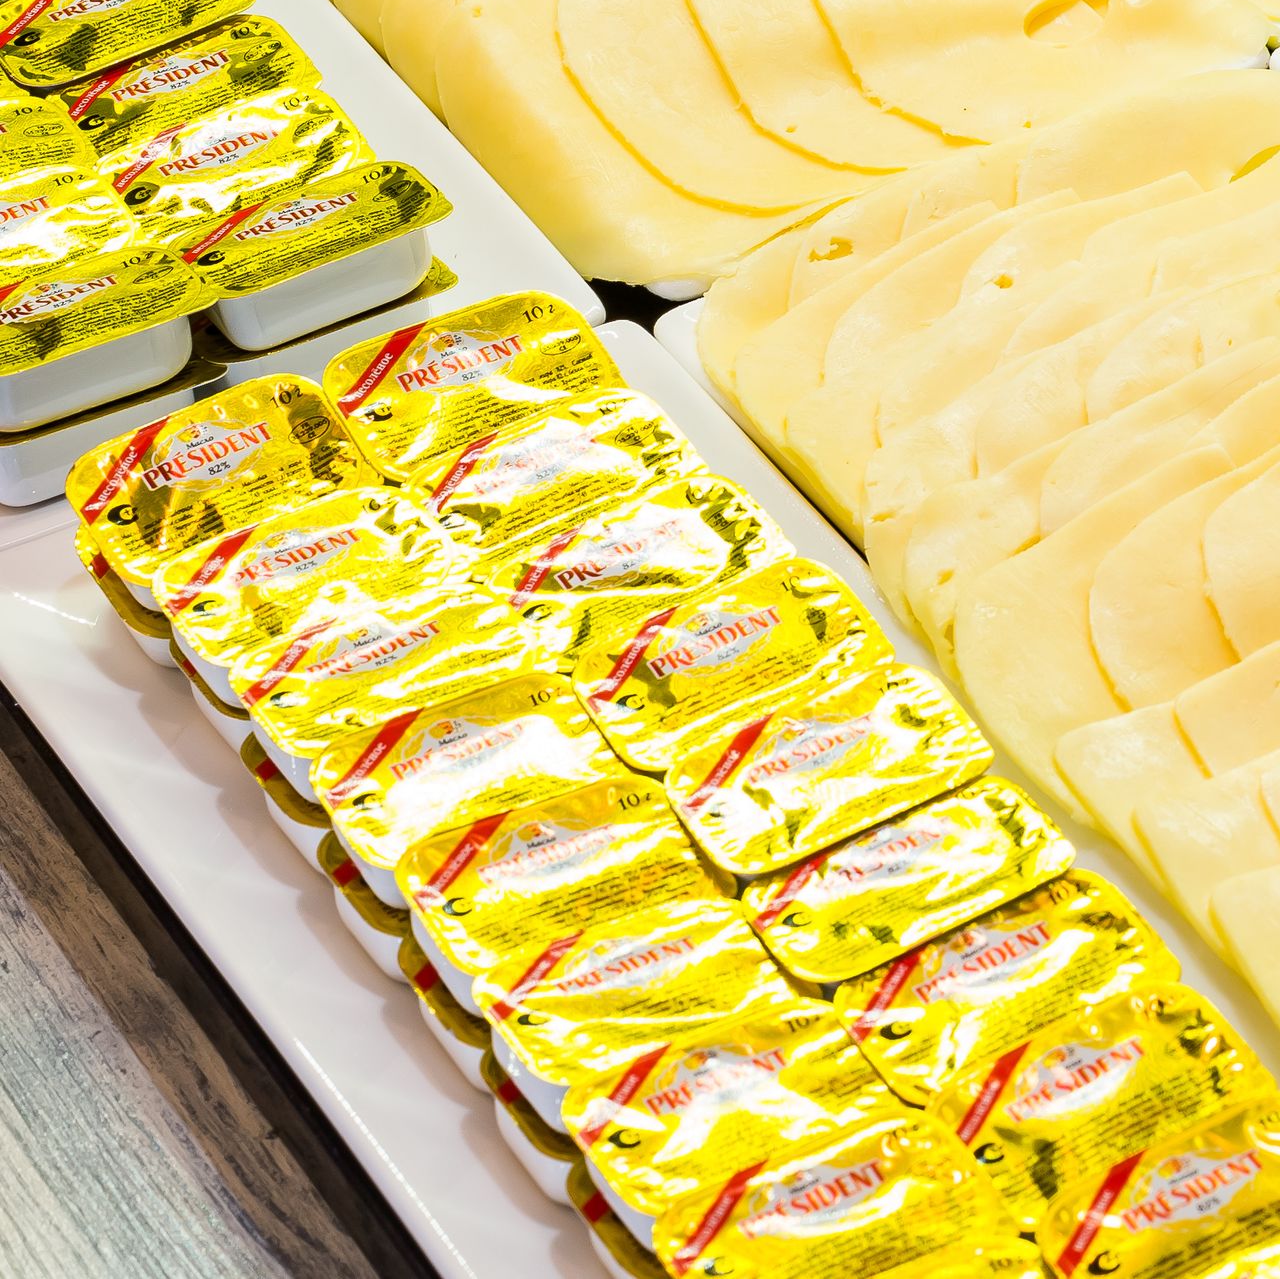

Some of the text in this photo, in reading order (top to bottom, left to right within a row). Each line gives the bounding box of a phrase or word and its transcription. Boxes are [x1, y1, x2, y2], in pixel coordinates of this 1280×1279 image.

[231, 26, 251, 40] 10
[110, 50, 231, 104] PRÉSIDENT
[169, 79, 191, 91] 82%
[283, 96, 302, 111] 10
[13, 106, 34, 118] 10
[218, 152, 240, 166] 82%
[52, 173, 75, 188] 10
[362, 170, 382, 185] 10
[235, 192, 359, 242] PRÉSIDENT
[294, 216, 316, 228] 82%
[122, 255, 142, 270] 10
[52, 297, 75, 310] 82%
[523, 305, 545, 324] 10
[396, 334, 526, 393] PRÉSIDENT
[270, 391, 293, 409] 10
[186, 434, 216, 451] Масло
[141, 421, 274, 491] PRÉSIDENT
[206, 459, 232, 477] 82%
[294, 560, 318, 573] 82%
[373, 654, 399, 668] 82%
[527, 691, 552, 709] 10
[616, 790, 641, 813] 10
